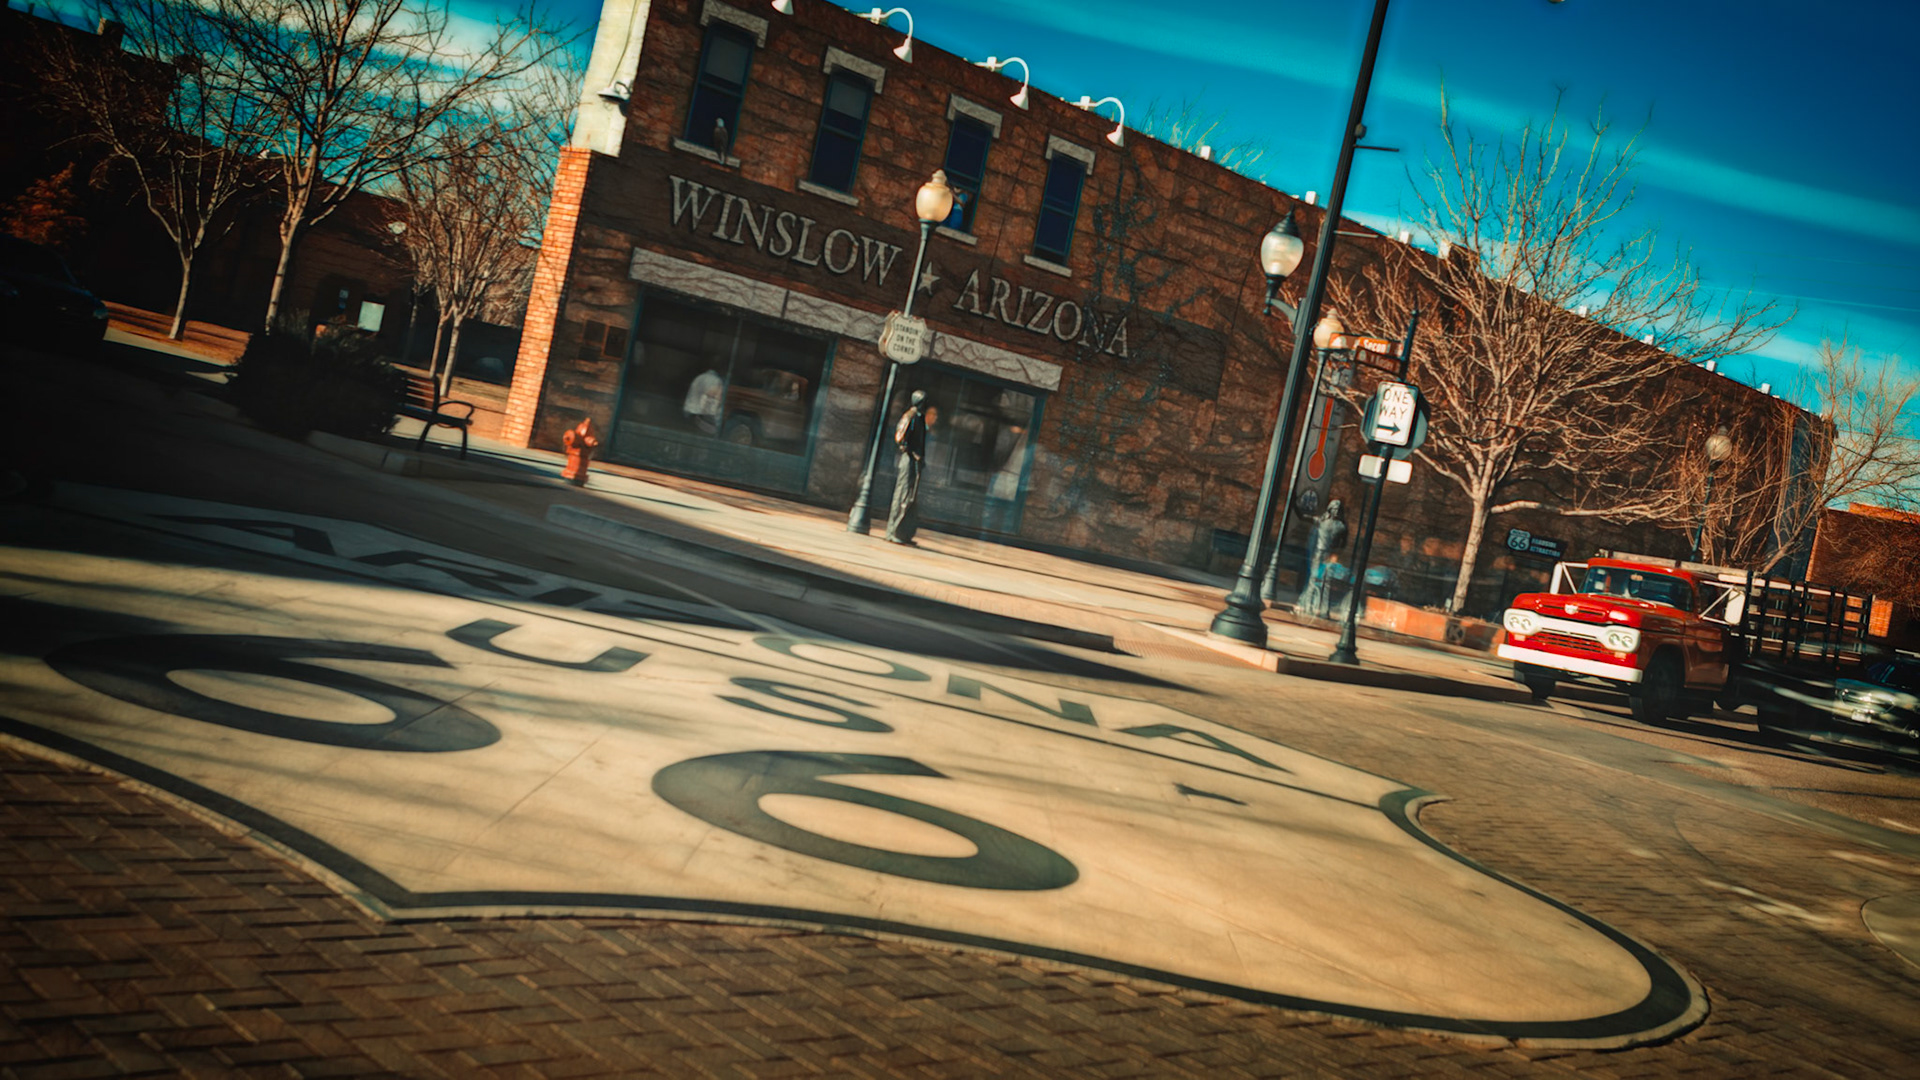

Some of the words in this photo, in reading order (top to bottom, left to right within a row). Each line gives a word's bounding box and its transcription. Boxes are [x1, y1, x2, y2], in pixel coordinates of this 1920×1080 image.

[669, 175, 903, 286] WINSLOW
[953, 269, 1128, 358] ARIZONA
[893, 343, 915, 355] CORNER
[1383, 388, 1411, 405] ONE
[1379, 404, 1407, 419] WAY
[1510, 536, 1526, 549] 66
[44, 633, 1080, 891] 66
